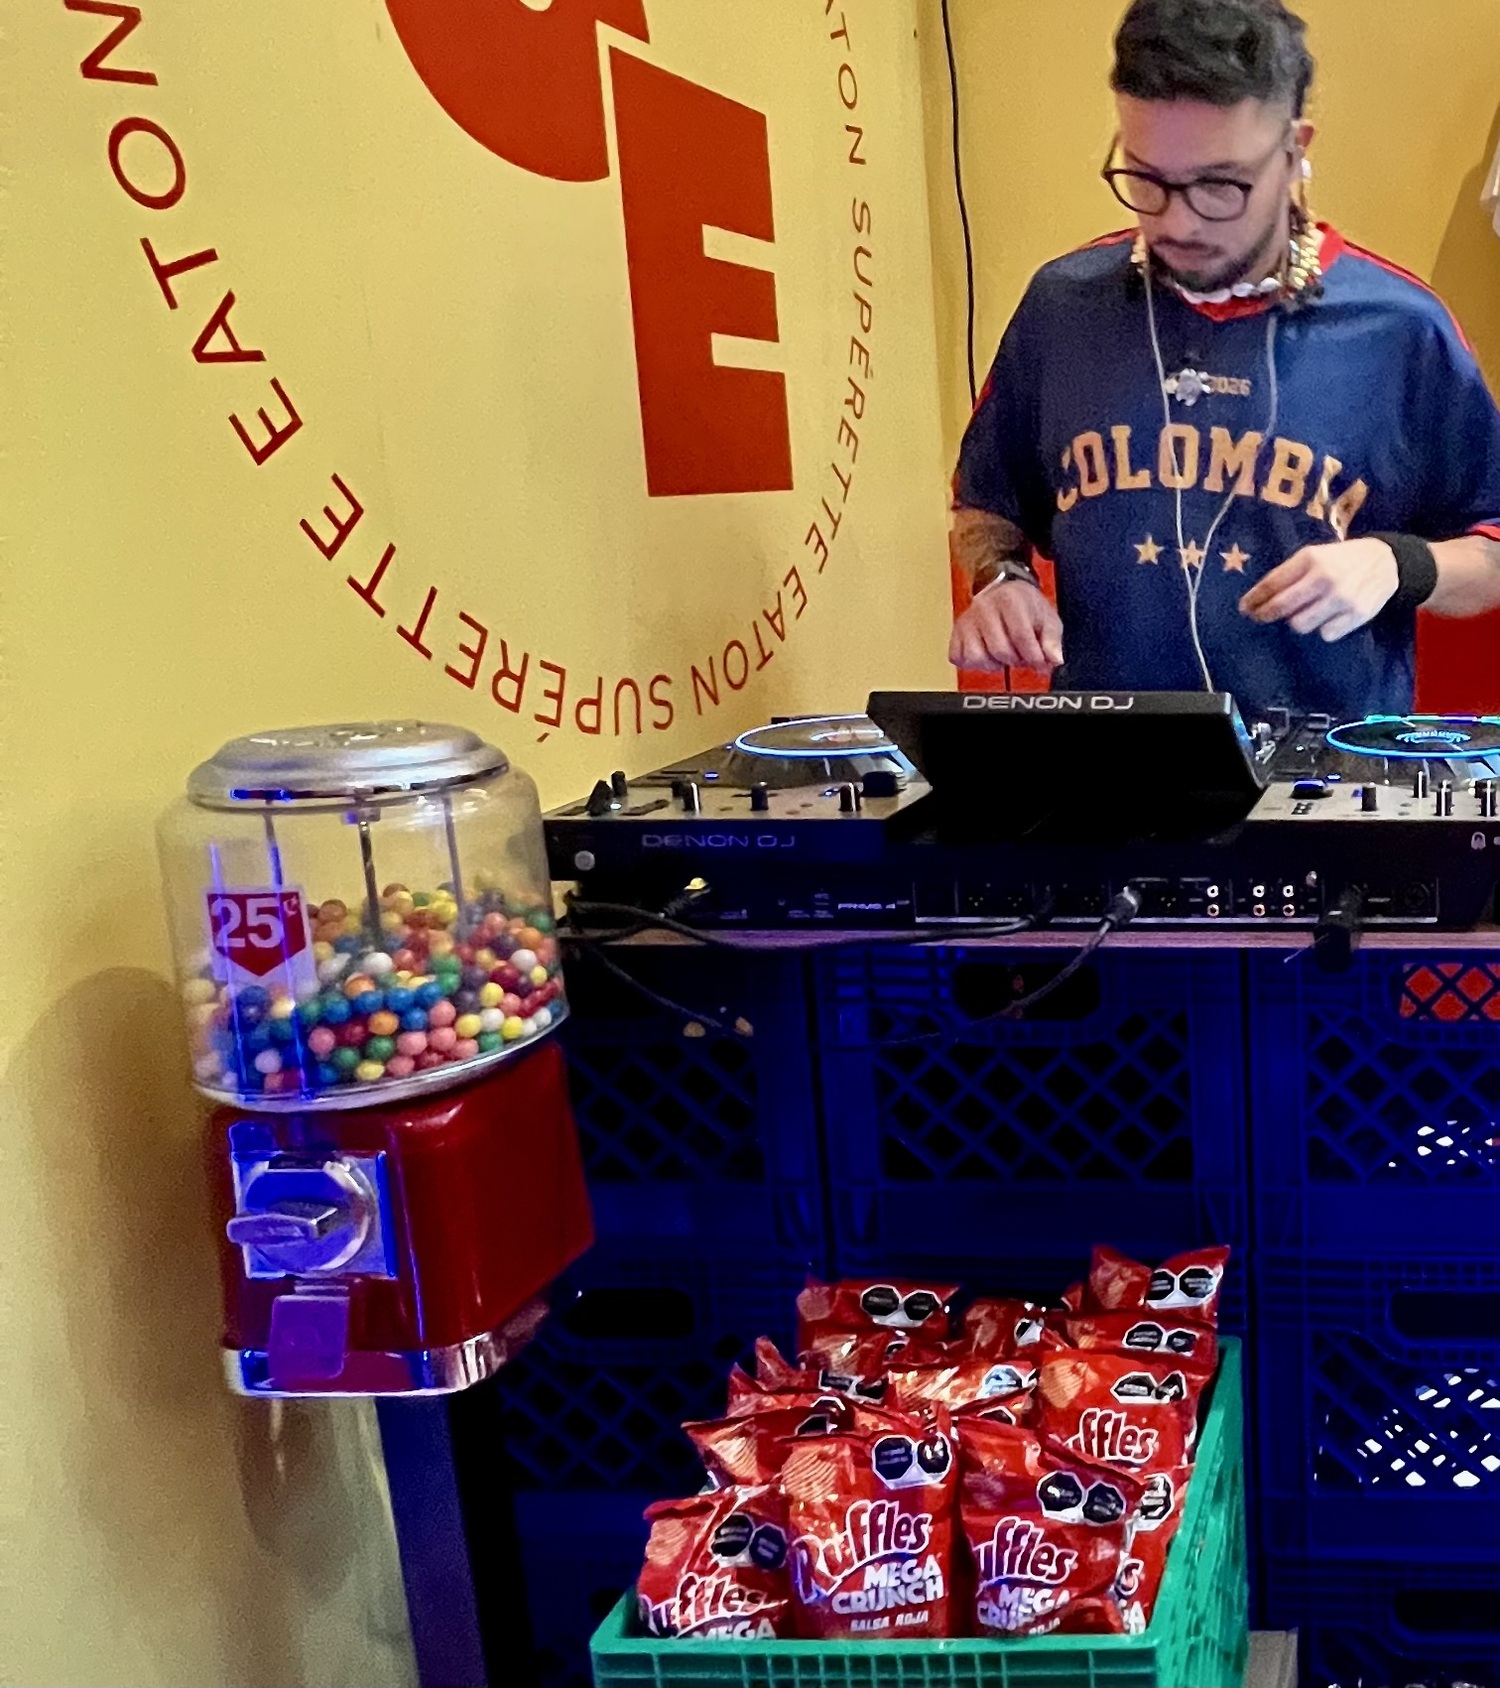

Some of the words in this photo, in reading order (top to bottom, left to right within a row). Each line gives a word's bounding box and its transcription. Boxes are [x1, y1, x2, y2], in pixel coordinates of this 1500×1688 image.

[825, 0, 867, 166] TON
[63, 0, 304, 467] EATON
[804, 197, 874, 576] SUPÉRETTE
[299, 472, 675, 744] SUPÉRETTE
[690, 565, 809, 717] EATON
[963, 696, 1083, 710] DENON
[1090, 696, 1134, 710] DJ
[641, 834, 749, 848] DENON
[757, 834, 796, 848] DJ
[791, 1498, 933, 1605] Ruffles
[863, 1554, 943, 1592] MEGA
[973, 1515, 1079, 1586] uffles
[640, 1571, 769, 1638] uffles
[831, 1576, 945, 1615] CRUNCH
